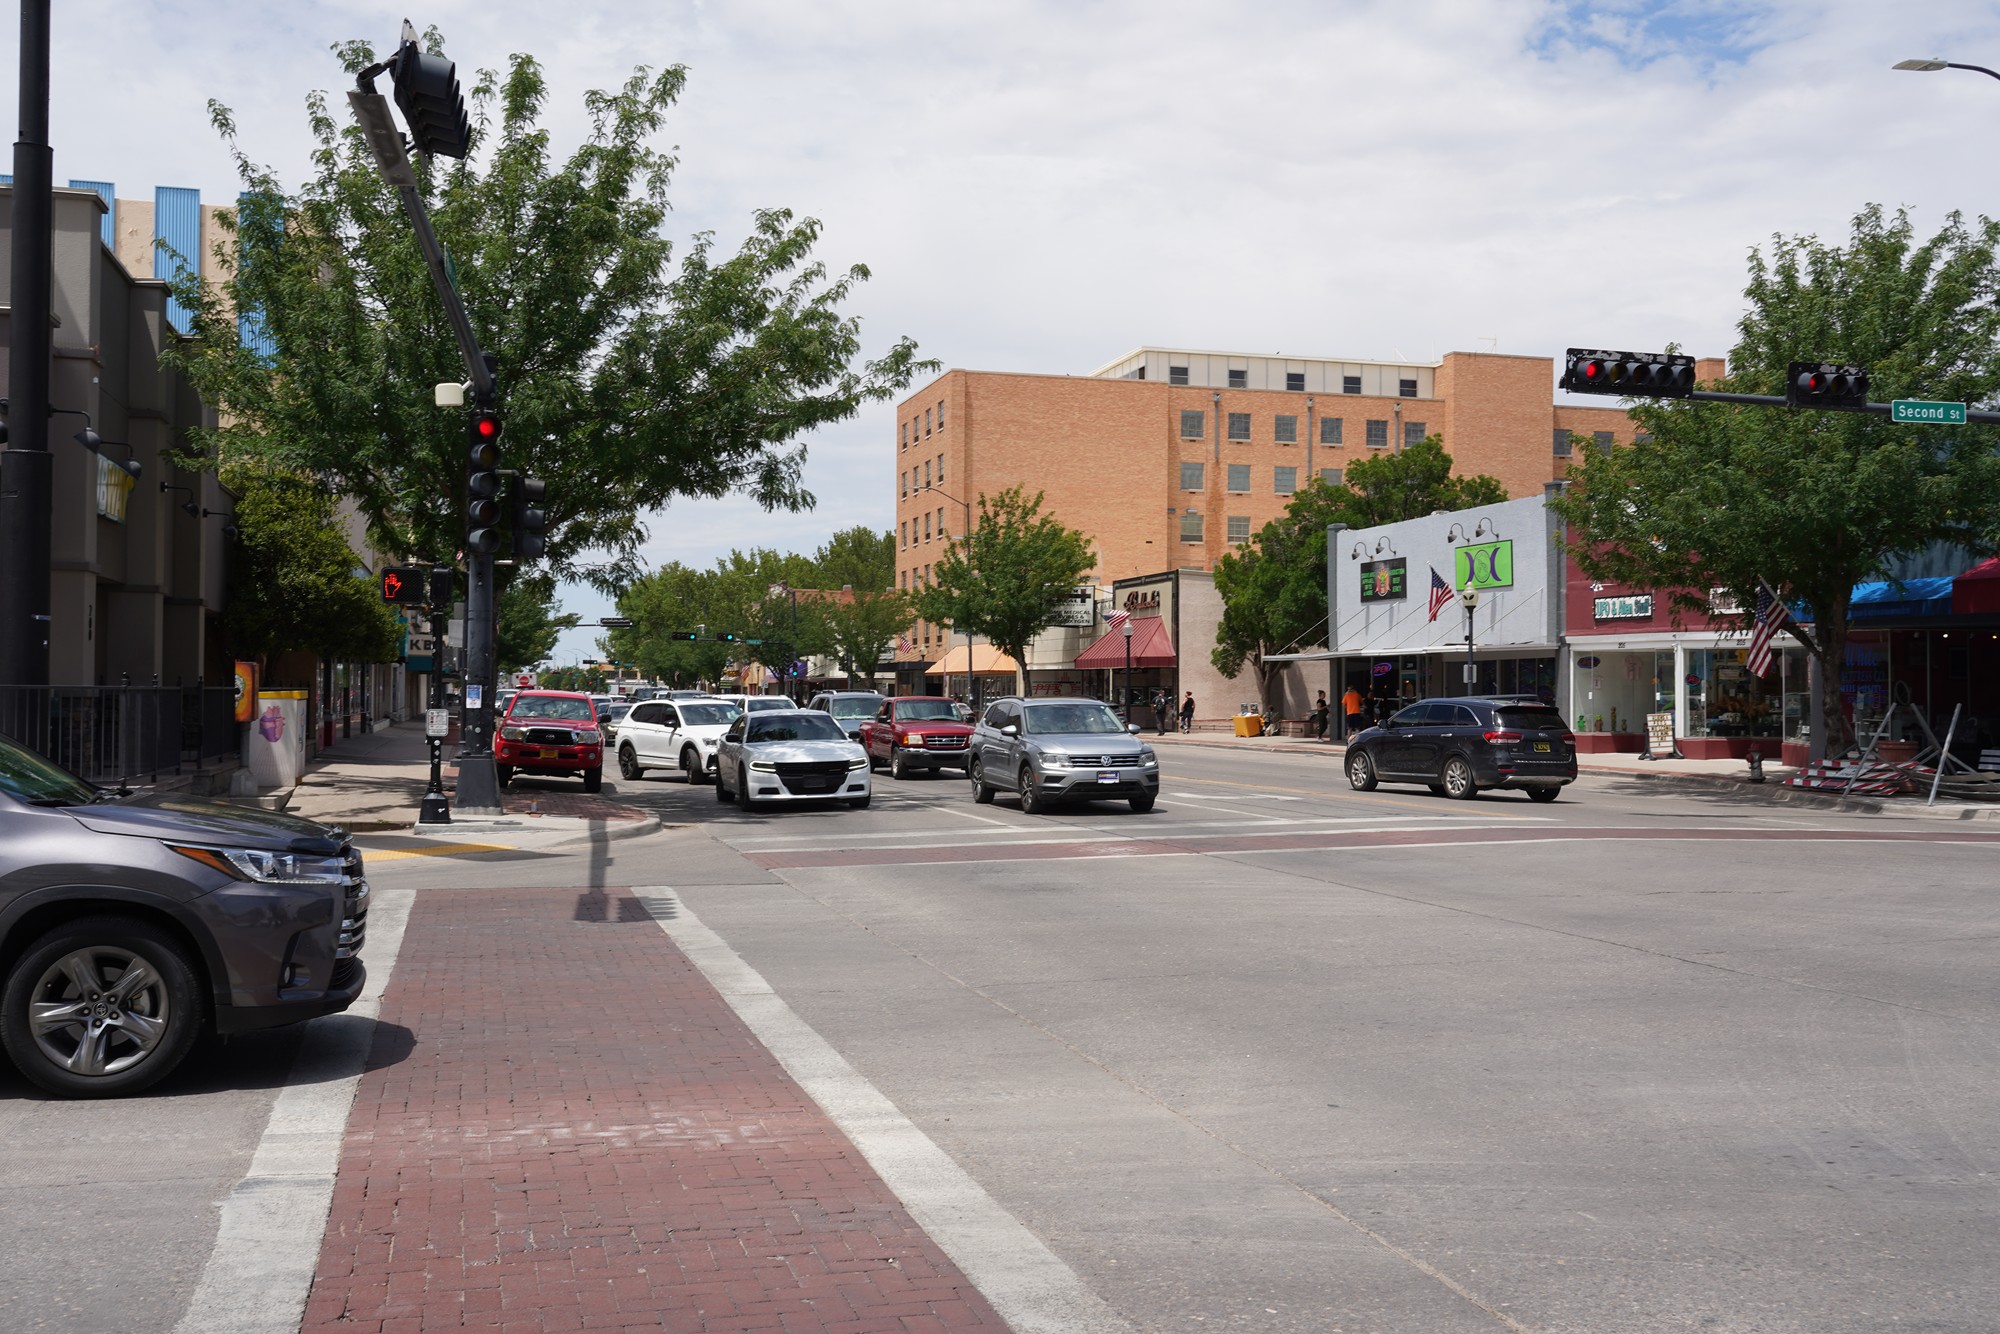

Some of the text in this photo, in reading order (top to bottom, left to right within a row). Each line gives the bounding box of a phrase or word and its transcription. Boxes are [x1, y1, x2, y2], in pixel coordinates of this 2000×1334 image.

[1898, 405, 1961, 419] Second St
[1595, 601, 1610, 616] UFO
[1611, 600, 1617, 616] &
[1618, 600, 1633, 615] Alien
